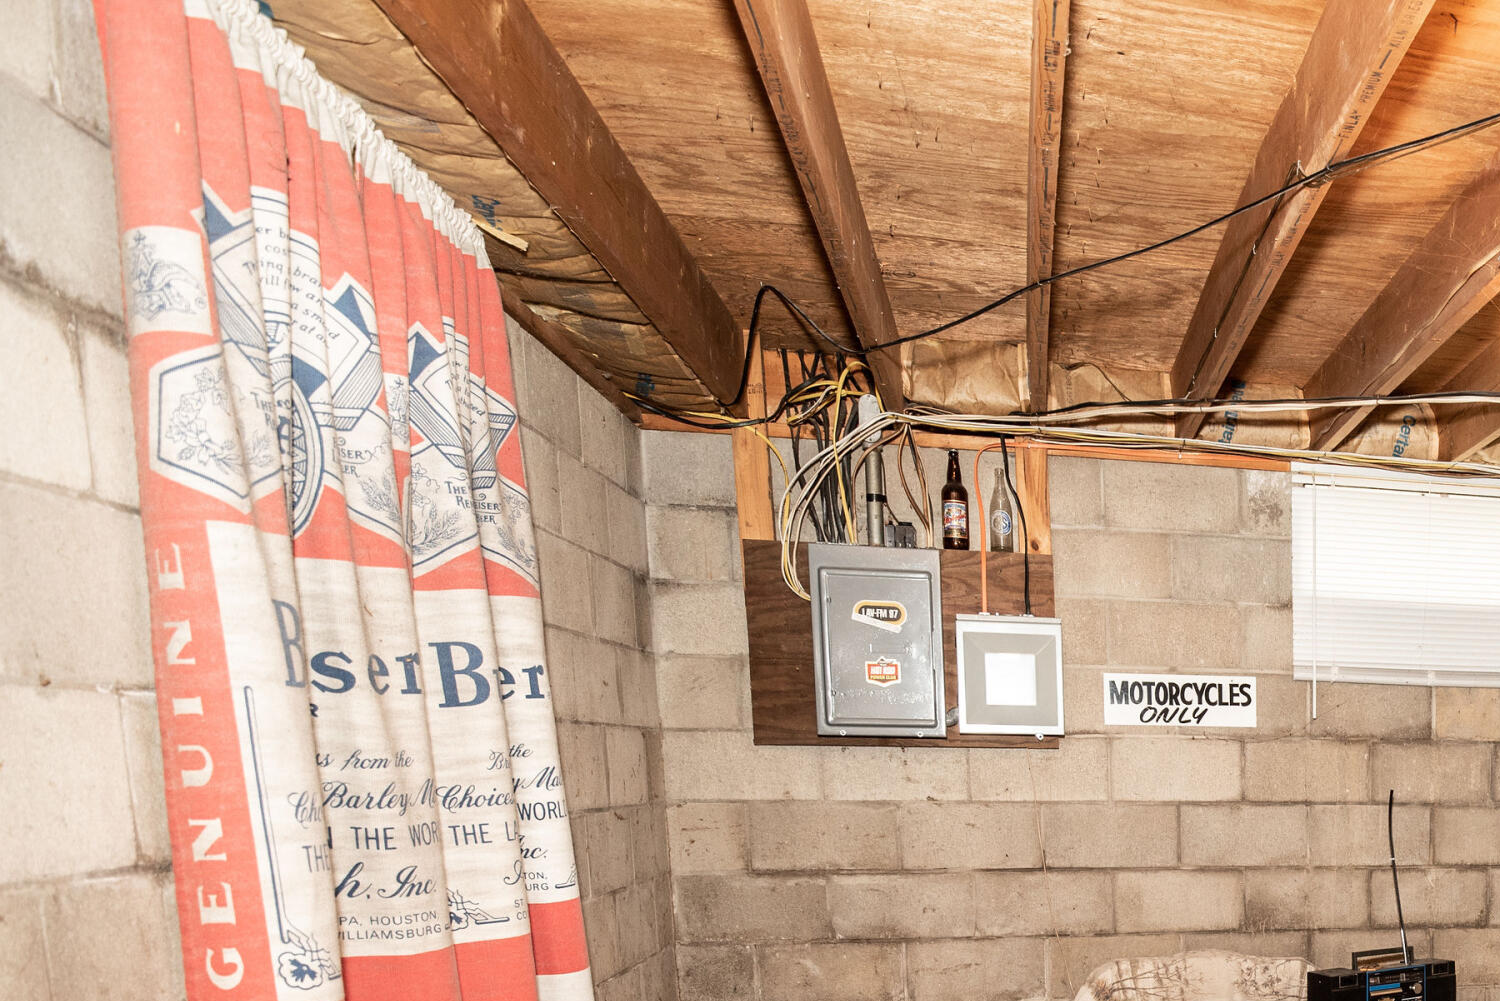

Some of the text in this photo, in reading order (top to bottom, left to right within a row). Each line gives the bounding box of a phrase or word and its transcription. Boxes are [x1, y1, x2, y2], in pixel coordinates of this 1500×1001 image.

[1108, 680, 1253, 707] MOTORCYCLES
[1139, 706, 1209, 724] ONLY
[154, 541, 245, 991] GENUINE
[340, 750, 414, 771] from the
[320, 780, 409, 817] Barley
[349, 826, 397, 851] THE
[407, 820, 439, 848] WOR
[447, 822, 492, 846] THE
[516, 800, 567, 821] WORL
